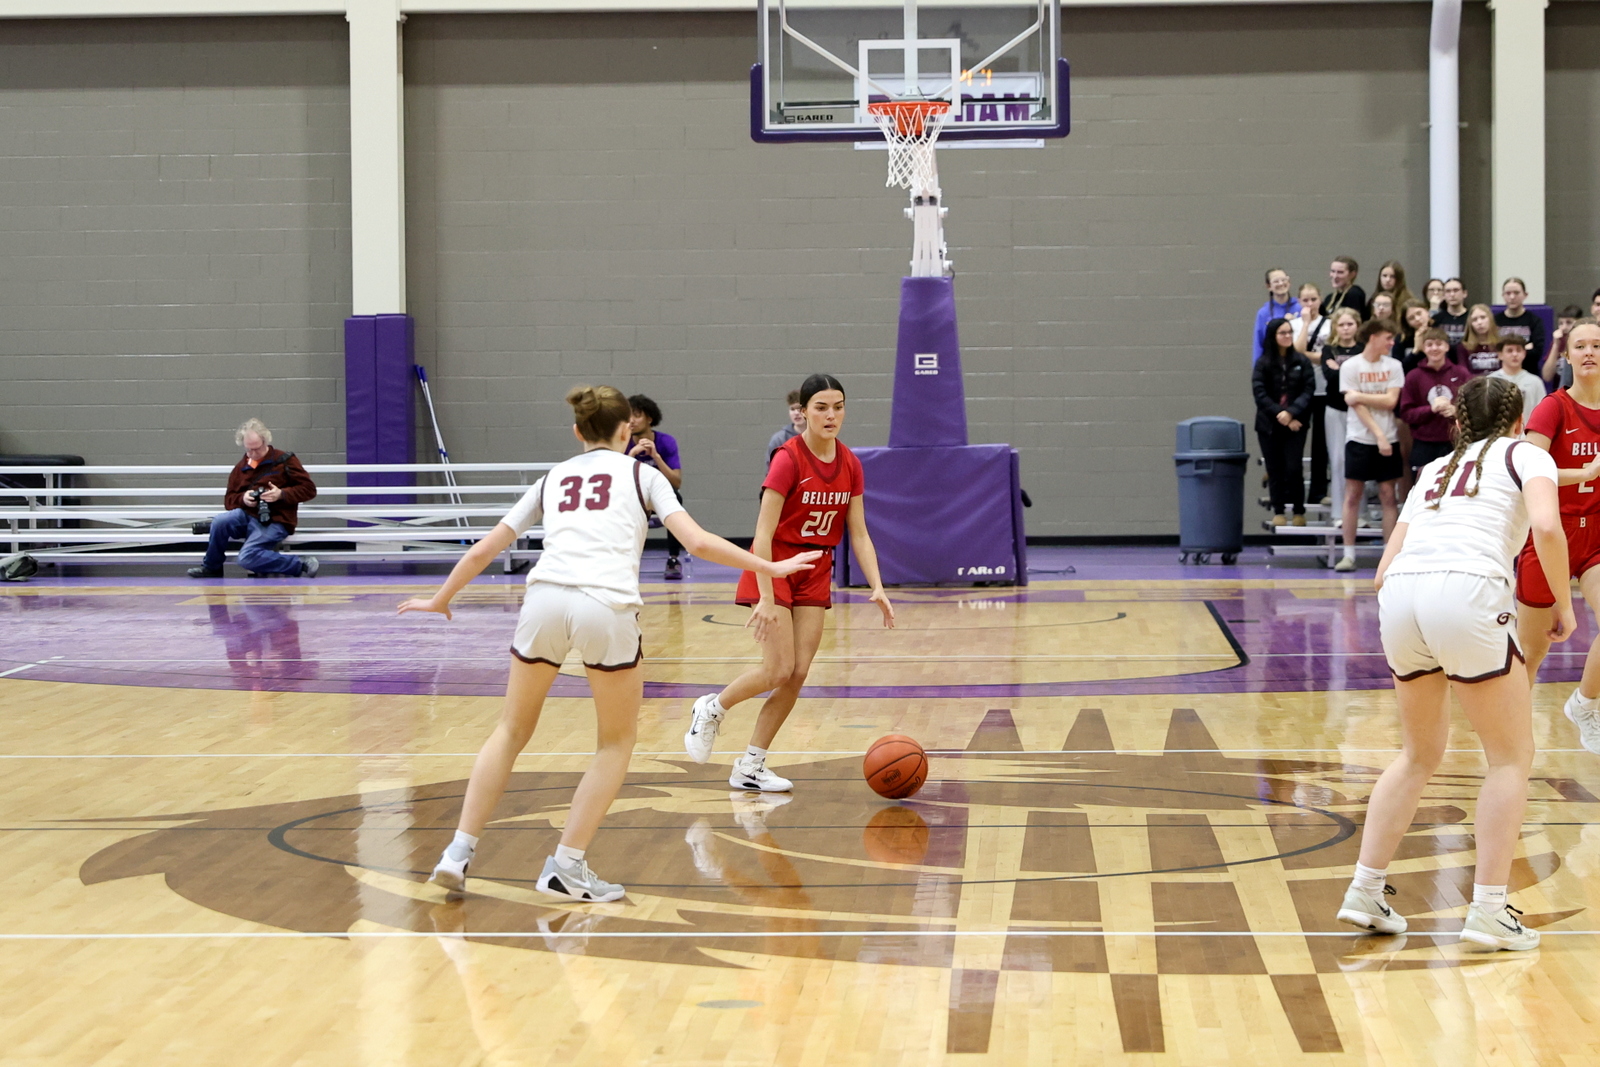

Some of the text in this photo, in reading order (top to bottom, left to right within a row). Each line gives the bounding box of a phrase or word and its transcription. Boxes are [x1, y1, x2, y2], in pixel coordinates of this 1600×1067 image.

[558, 473, 613, 513] 33
[1424, 460, 1478, 501] 31
[800, 510, 838, 538] 20
[1580, 517, 1586, 527] B
